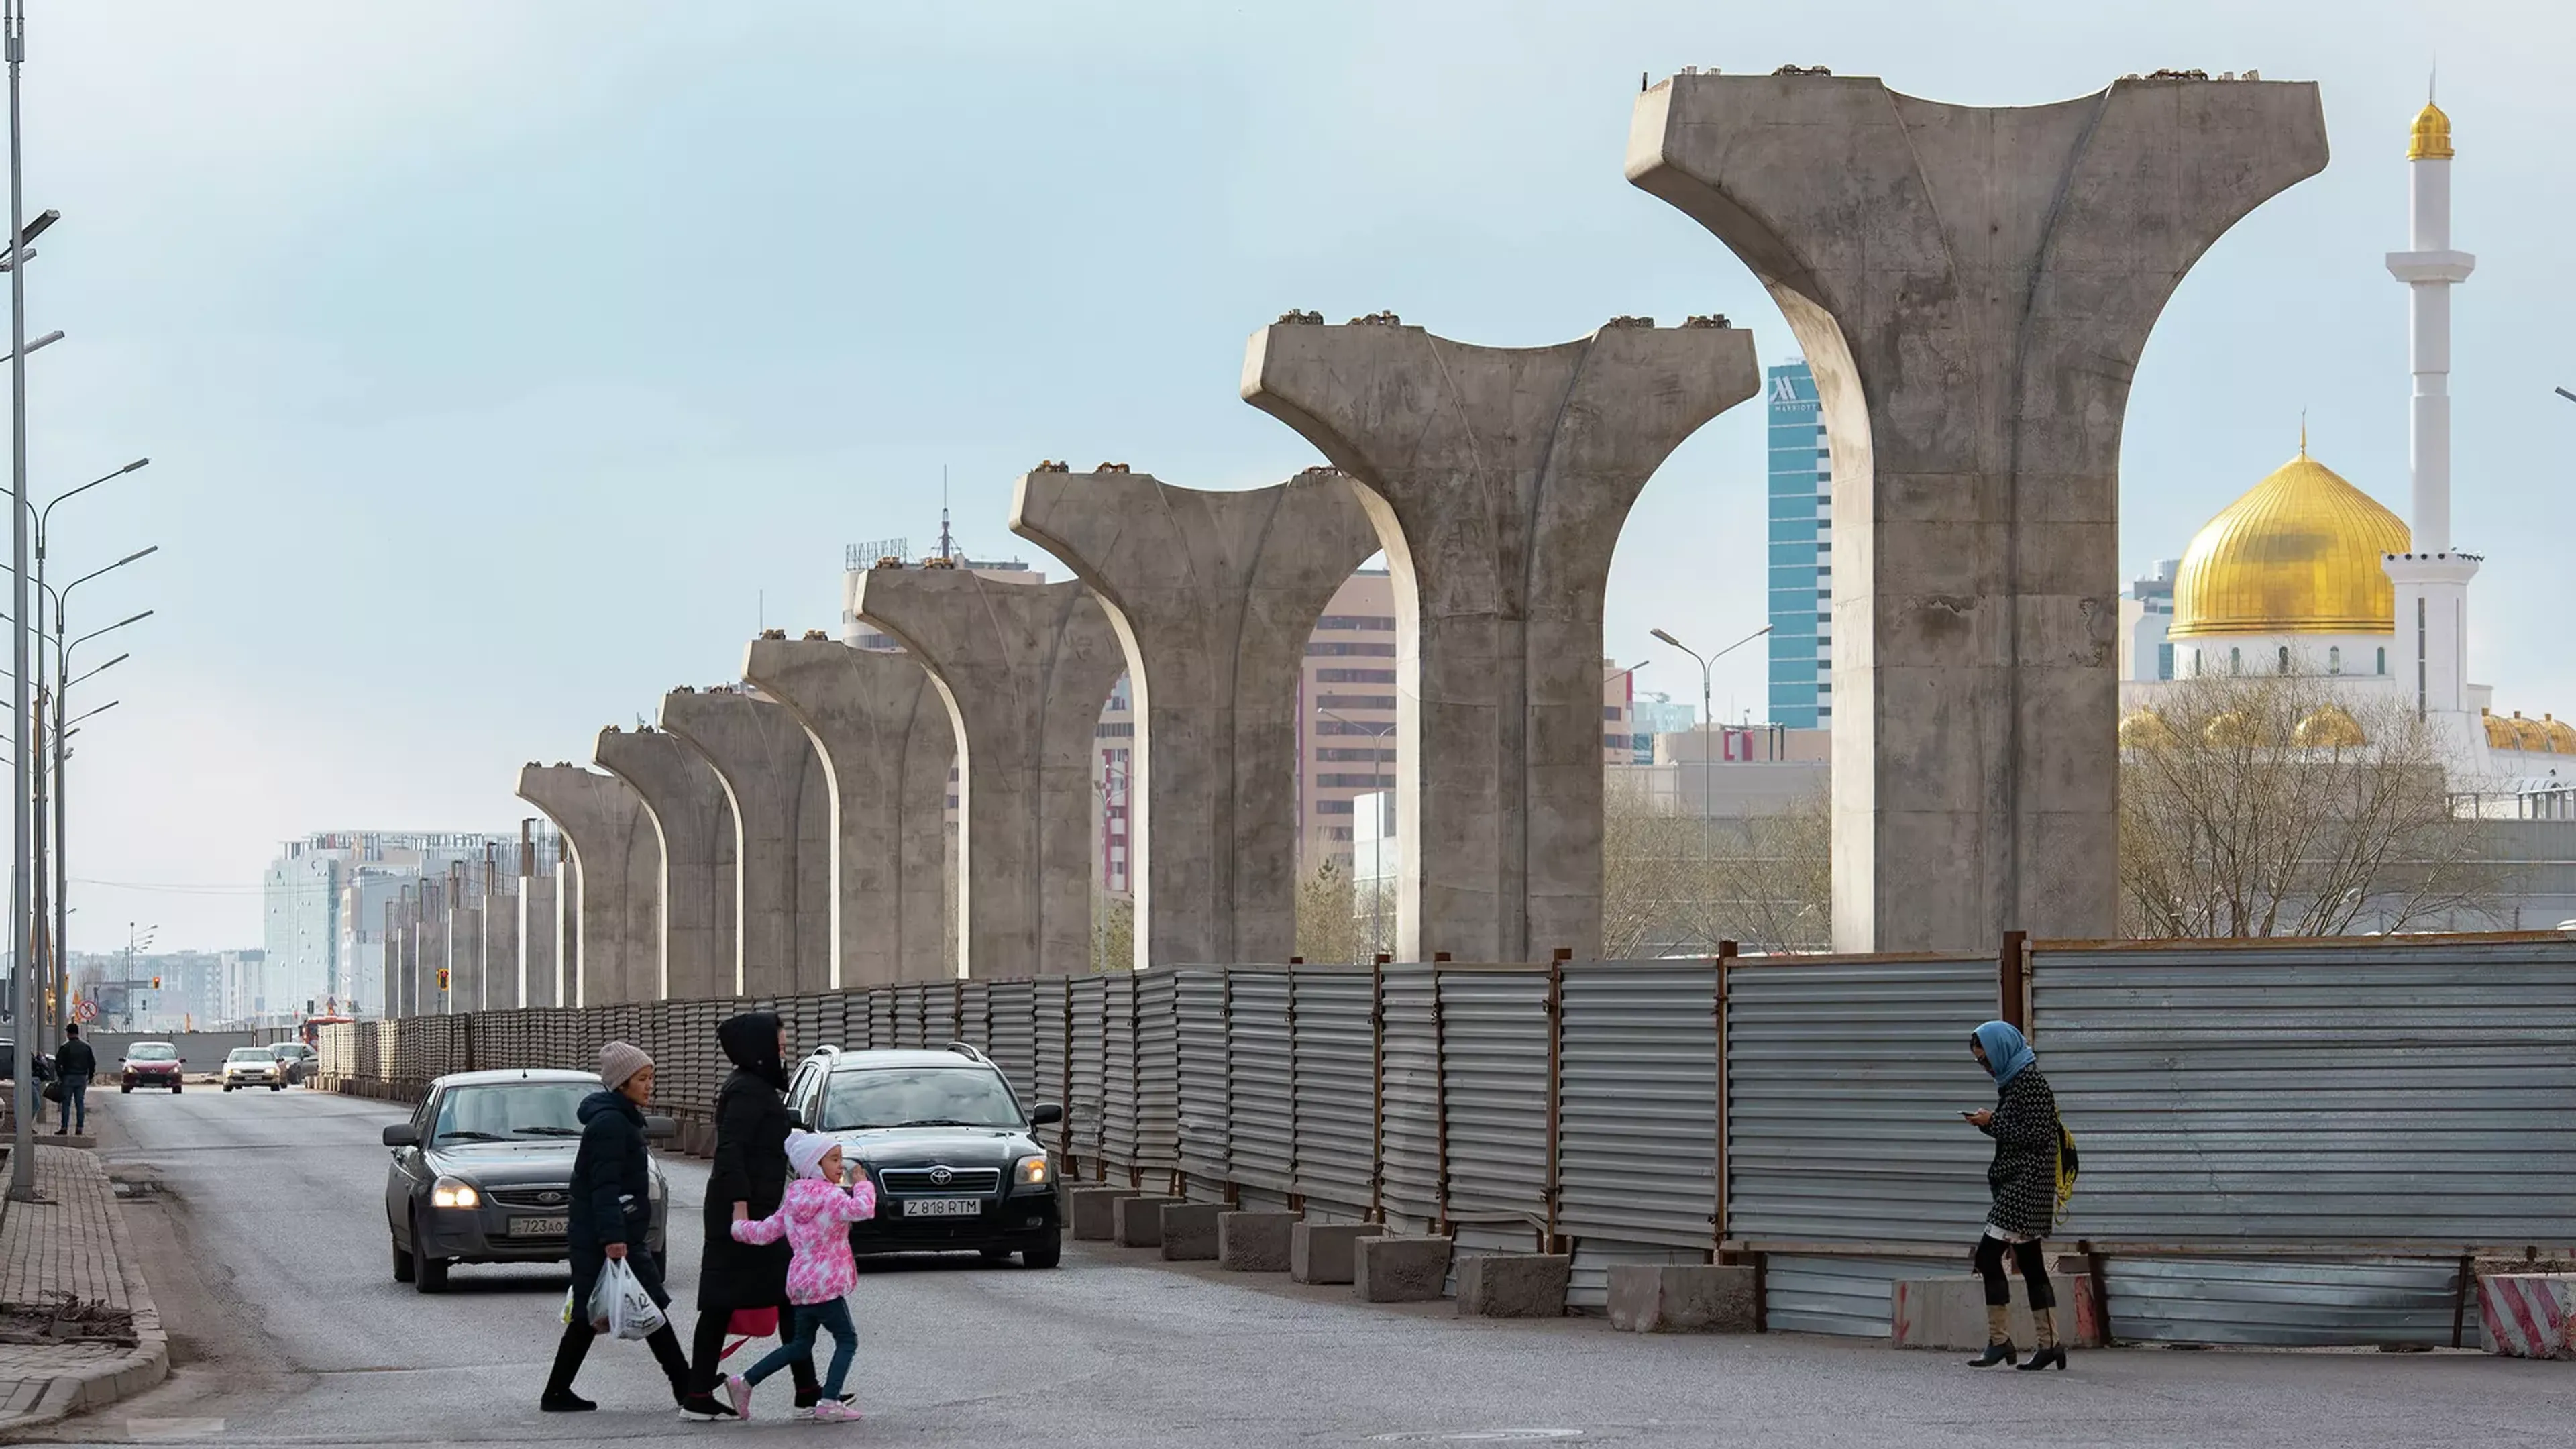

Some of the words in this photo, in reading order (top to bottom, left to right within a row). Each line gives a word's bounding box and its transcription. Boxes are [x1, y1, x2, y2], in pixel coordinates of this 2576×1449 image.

[1775, 404, 1816, 413] MARRIOTT
[908, 1201, 917, 1214] Z
[921, 1201, 945, 1214] 818
[948, 1200, 977, 1214] RTM
